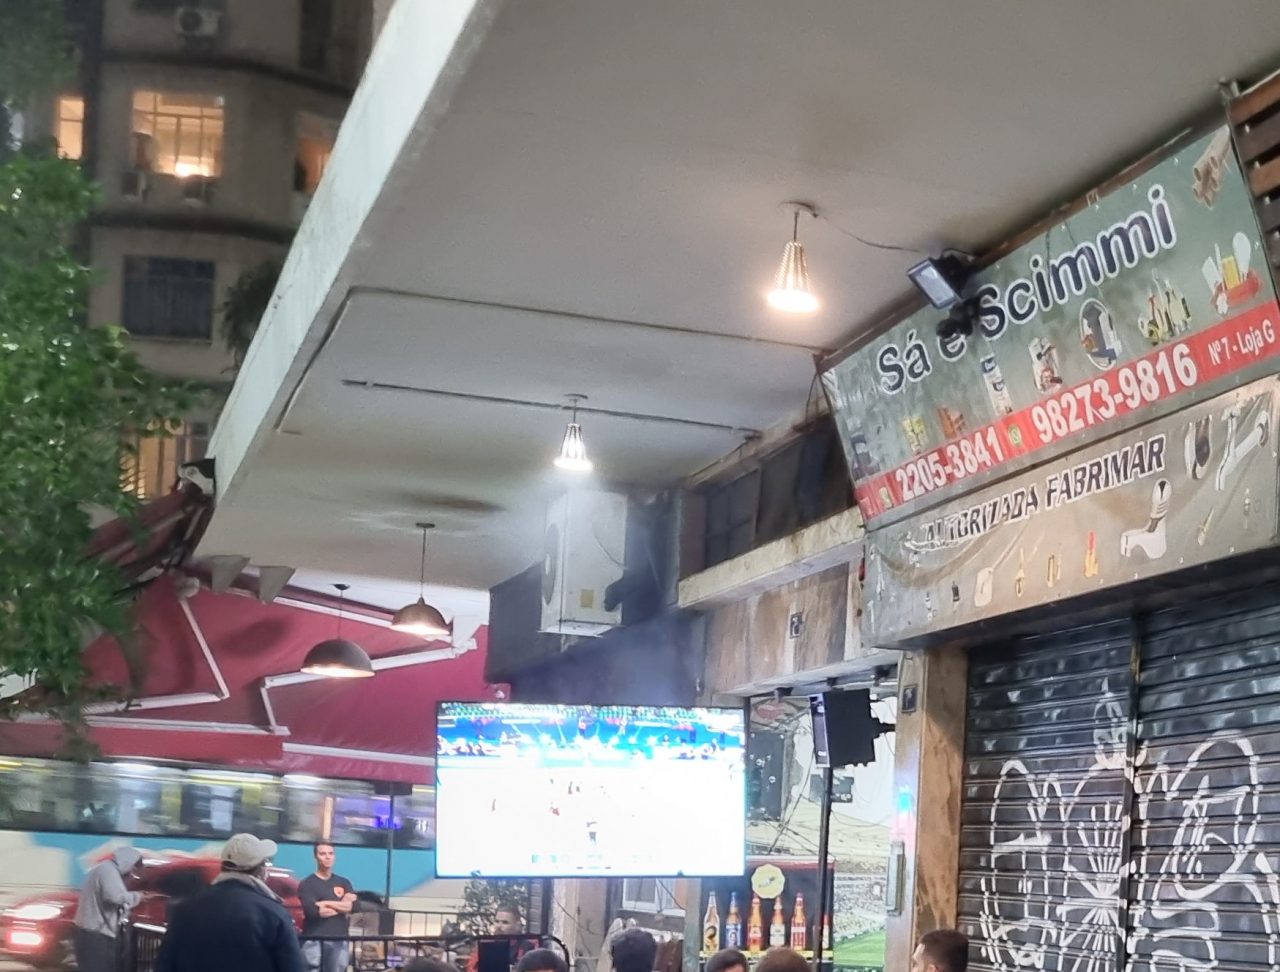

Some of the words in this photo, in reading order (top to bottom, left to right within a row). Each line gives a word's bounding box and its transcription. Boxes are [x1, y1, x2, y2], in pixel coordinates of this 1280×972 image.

[878, 329, 932, 394] Sá
[976, 184, 1176, 340] Scimmi
[1221, 336, 1231, 360] 7
[1236, 326, 1264, 356] Loja
[1262, 319, 1275, 343] G
[895, 425, 1004, 501] 2205-3841
[1032, 343, 1197, 443] 98273-9816
[1045, 433, 1166, 509] FABRIMAR
